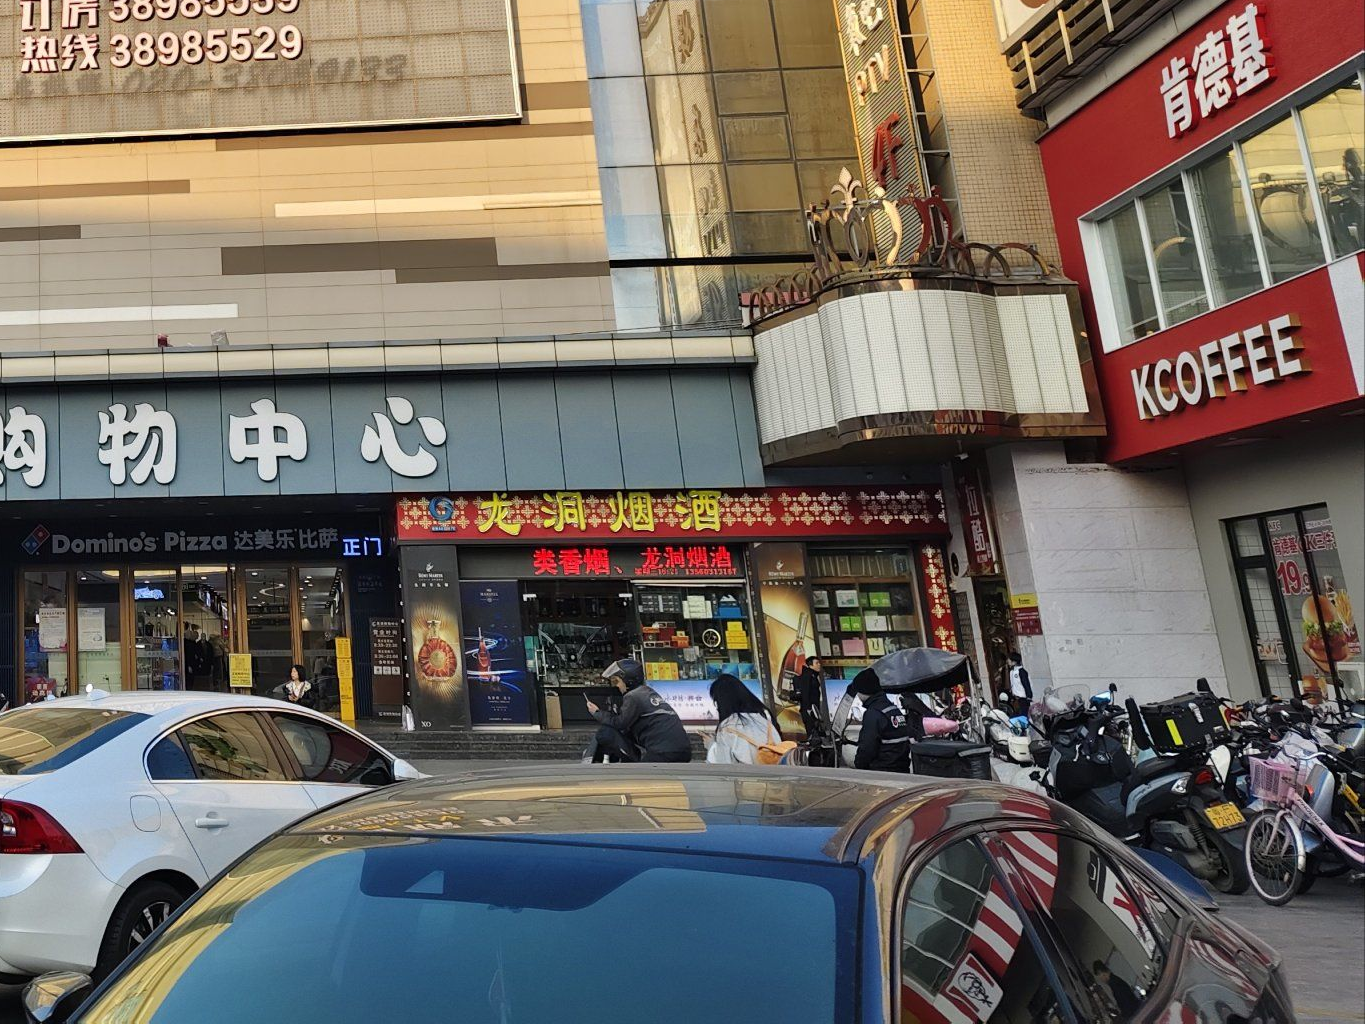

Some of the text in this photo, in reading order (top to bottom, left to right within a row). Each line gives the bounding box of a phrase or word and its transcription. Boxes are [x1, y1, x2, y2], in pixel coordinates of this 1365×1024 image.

[20, 25, 304, 74] 热线 38985529
[1159, 1, 1276, 139] 肯德基
[1131, 313, 1309, 421] KCOFFEE
[477, 490, 722, 536] 龙洞烟酒
[51, 527, 338, 556] Domino's Pizza 达美乐比萨
[342, 535, 383, 558] 正门
